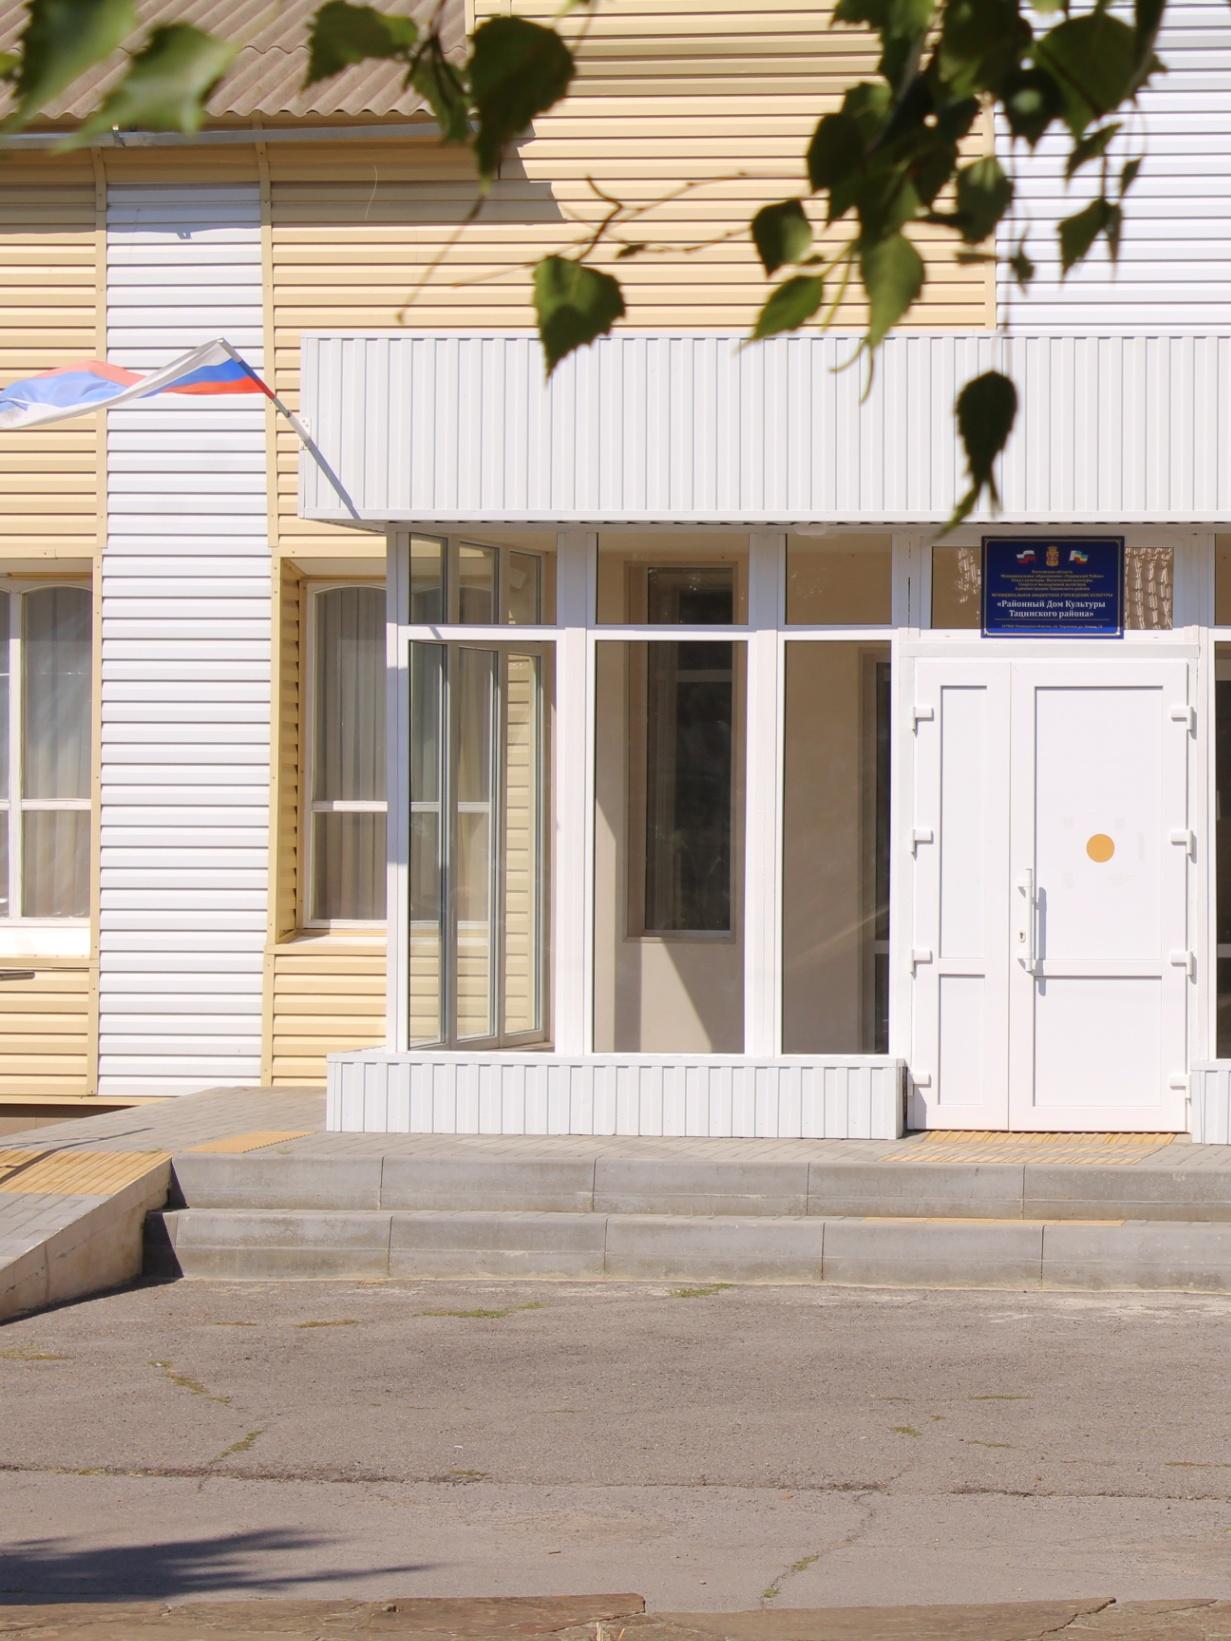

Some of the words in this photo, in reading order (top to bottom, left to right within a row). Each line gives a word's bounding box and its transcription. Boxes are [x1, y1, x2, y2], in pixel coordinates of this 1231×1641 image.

[997, 599, 1045, 608] «Районный
[1046, 599, 1064, 609] Дом
[1065, 599, 1106, 609] Культуры
[1009, 609, 1057, 618] Тацинского
[1058, 610, 1094, 619] района»
